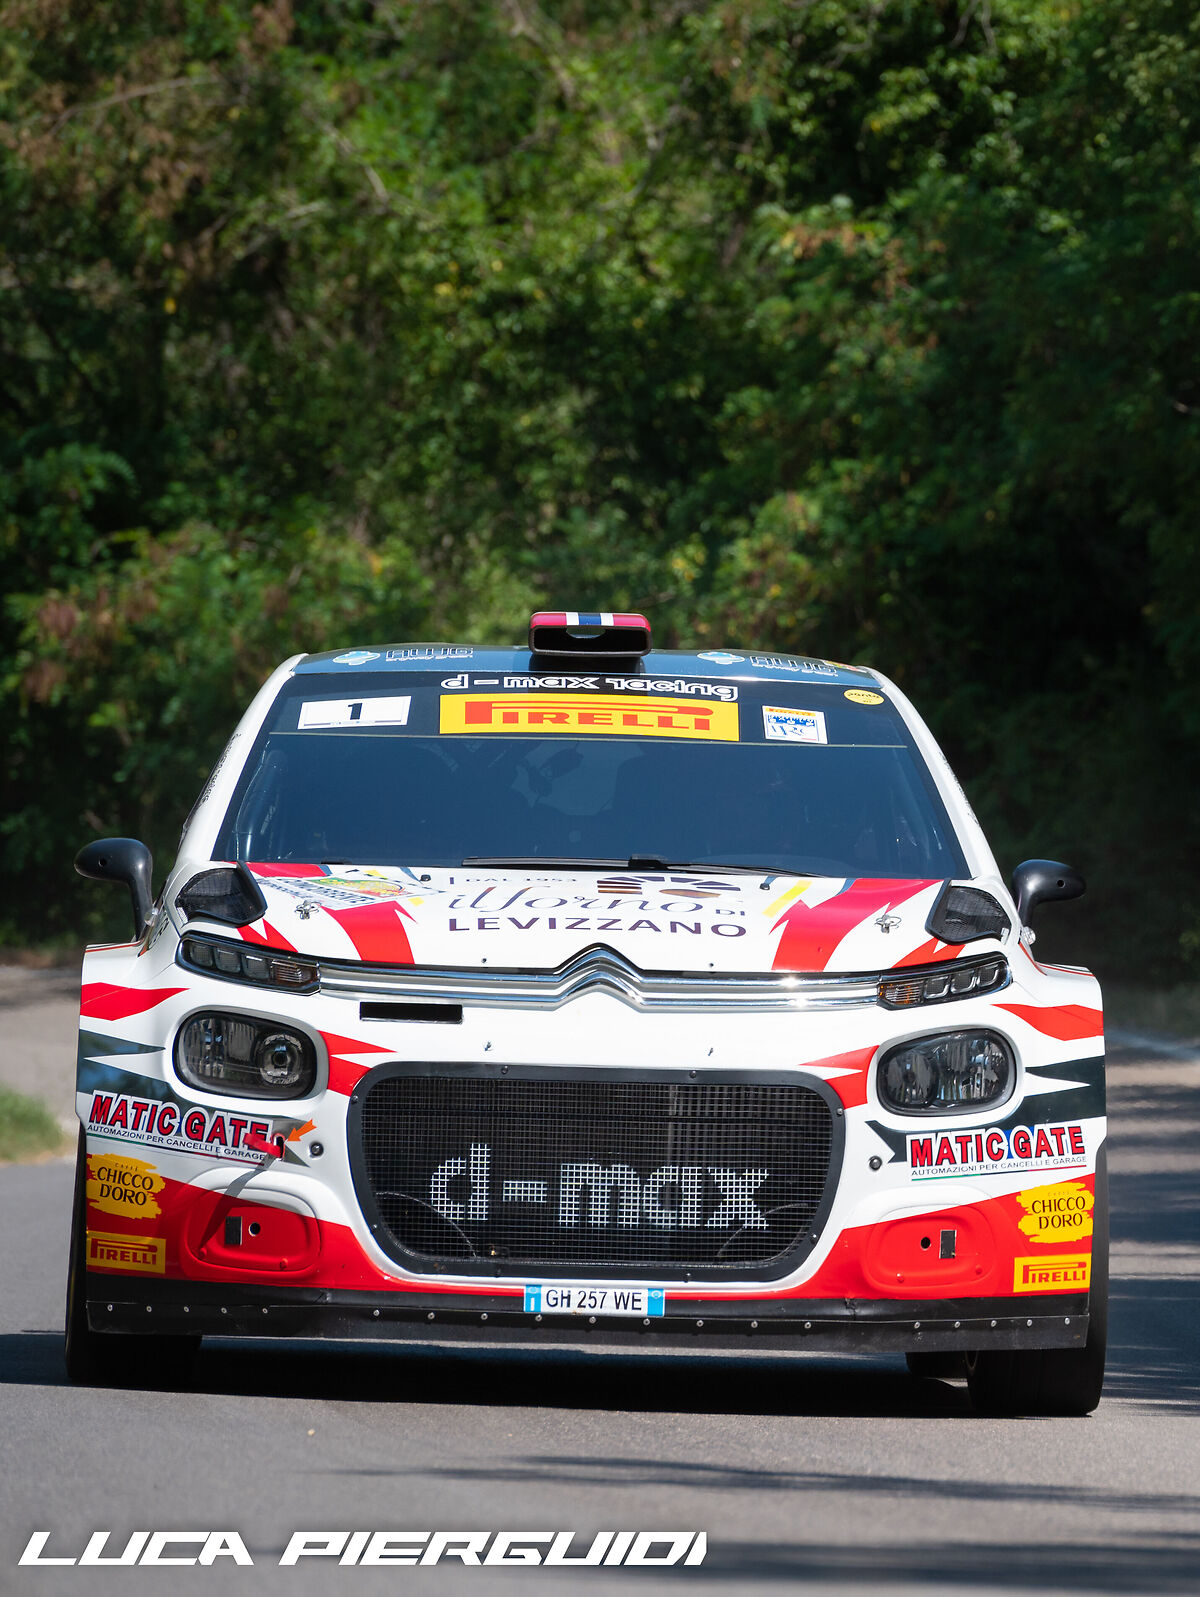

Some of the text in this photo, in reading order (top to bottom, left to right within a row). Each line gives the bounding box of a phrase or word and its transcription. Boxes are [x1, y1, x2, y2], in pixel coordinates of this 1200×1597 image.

[605, 678, 739, 702] racing
[347, 702, 363, 721] 1
[464, 700, 714, 731] PIRELLI
[715, 908, 746, 917] DI
[449, 917, 747, 938] LEVIZZANO
[89, 1095, 270, 1150] MATIC GATE
[87, 1124, 145, 1141] AUTOMAZIONI
[146, 1135, 165, 1145] PER
[166, 1138, 216, 1153] CANCELLI
[223, 1148, 266, 1161] GARAGE
[910, 1126, 1086, 1168] MATIC GATE
[911, 1166, 977, 1176] AUTOMAZIONI
[979, 1163, 998, 1171] PER
[1000, 1160, 1043, 1169] CANCELLI
[1052, 1156, 1087, 1165] GARAGE
[97, 1166, 154, 1191] CHICCO
[429, 1142, 770, 1231] d-max
[99, 1183, 147, 1206] D'ORO
[1031, 1195, 1086, 1214] CHICCO
[1038, 1212, 1083, 1230] D'ORO
[90, 1237, 158, 1265] PIRELLI
[1022, 1261, 1087, 1284] PIRELLI
[545, 1289, 571, 1308] GH
[577, 1290, 608, 1309] 257
[613, 1291, 642, 1311] WE
